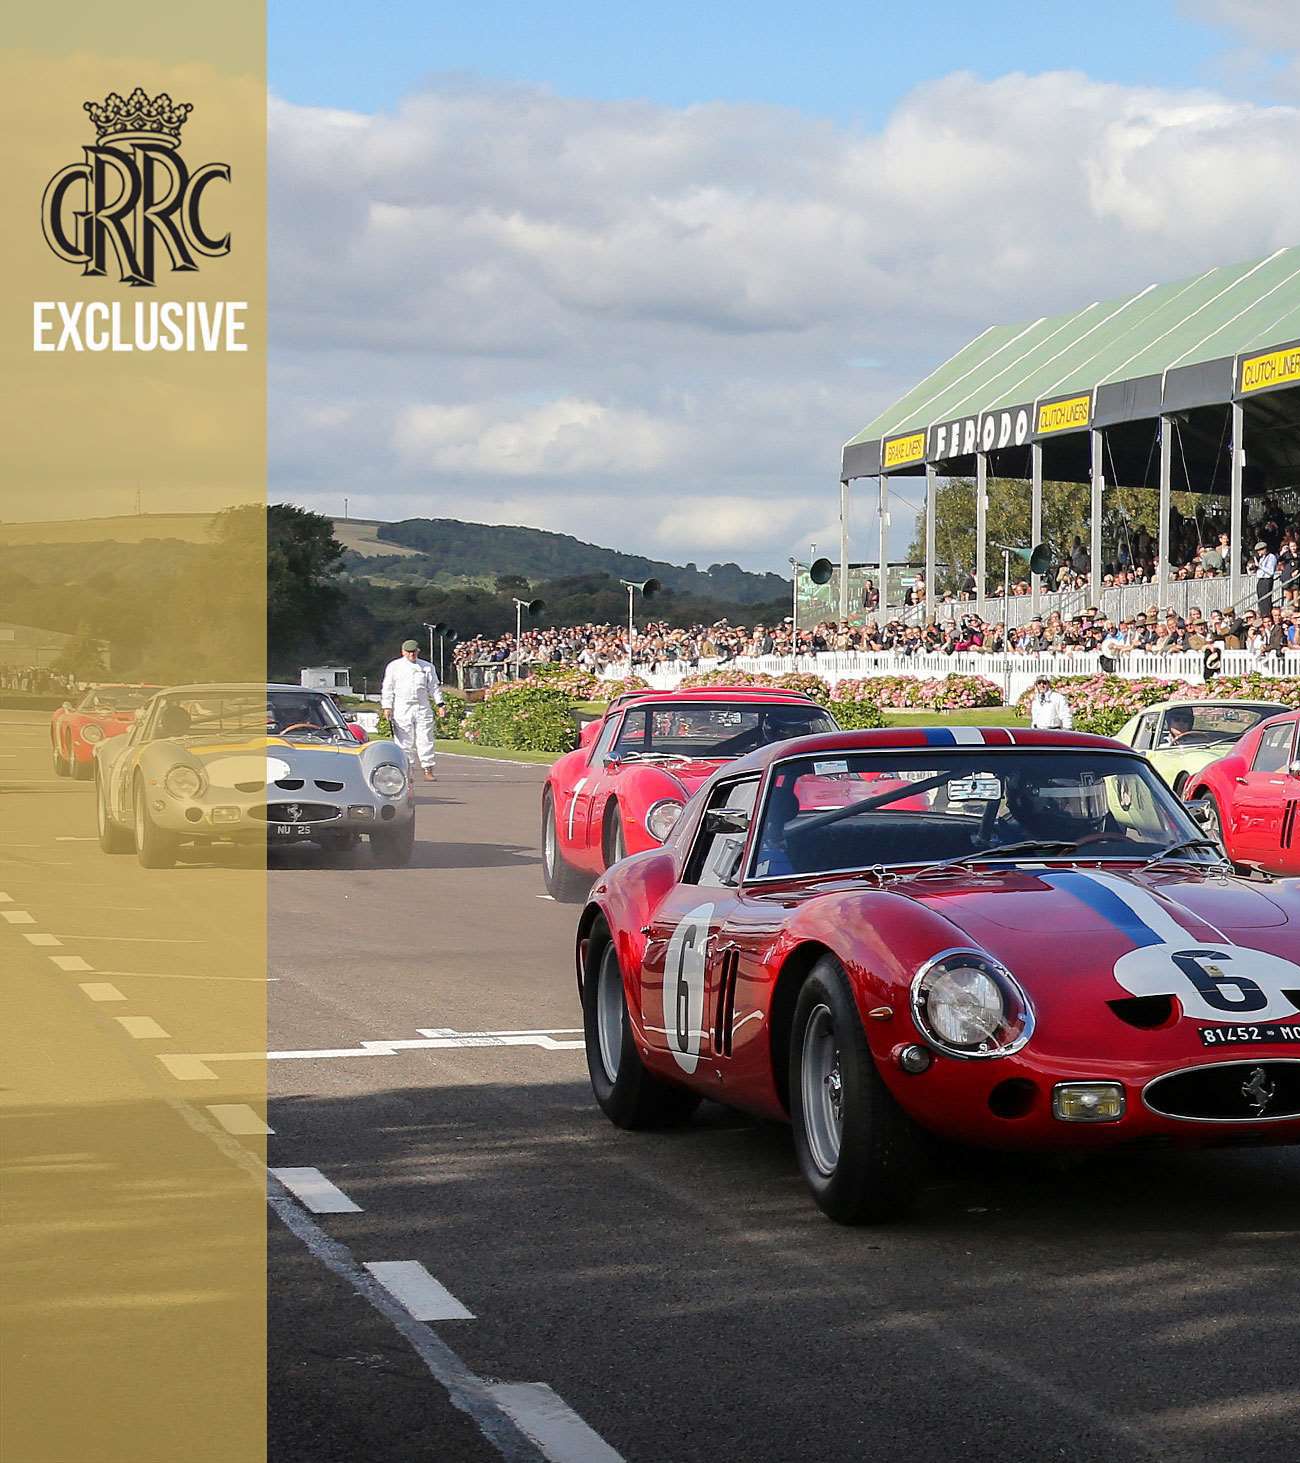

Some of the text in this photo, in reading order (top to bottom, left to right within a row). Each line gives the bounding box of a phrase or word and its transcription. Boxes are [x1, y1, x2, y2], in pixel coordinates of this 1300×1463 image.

[1244, 359, 1277, 386] CLUTCH
[1040, 402, 1088, 428] CLUTCH LINERS
[935, 410, 1028, 461] FERODO
[297, 825, 311, 835] 25
[676, 924, 697, 1053] 6
[1171, 949, 1268, 1012] 6
[1203, 1026, 1262, 1043] 81452
